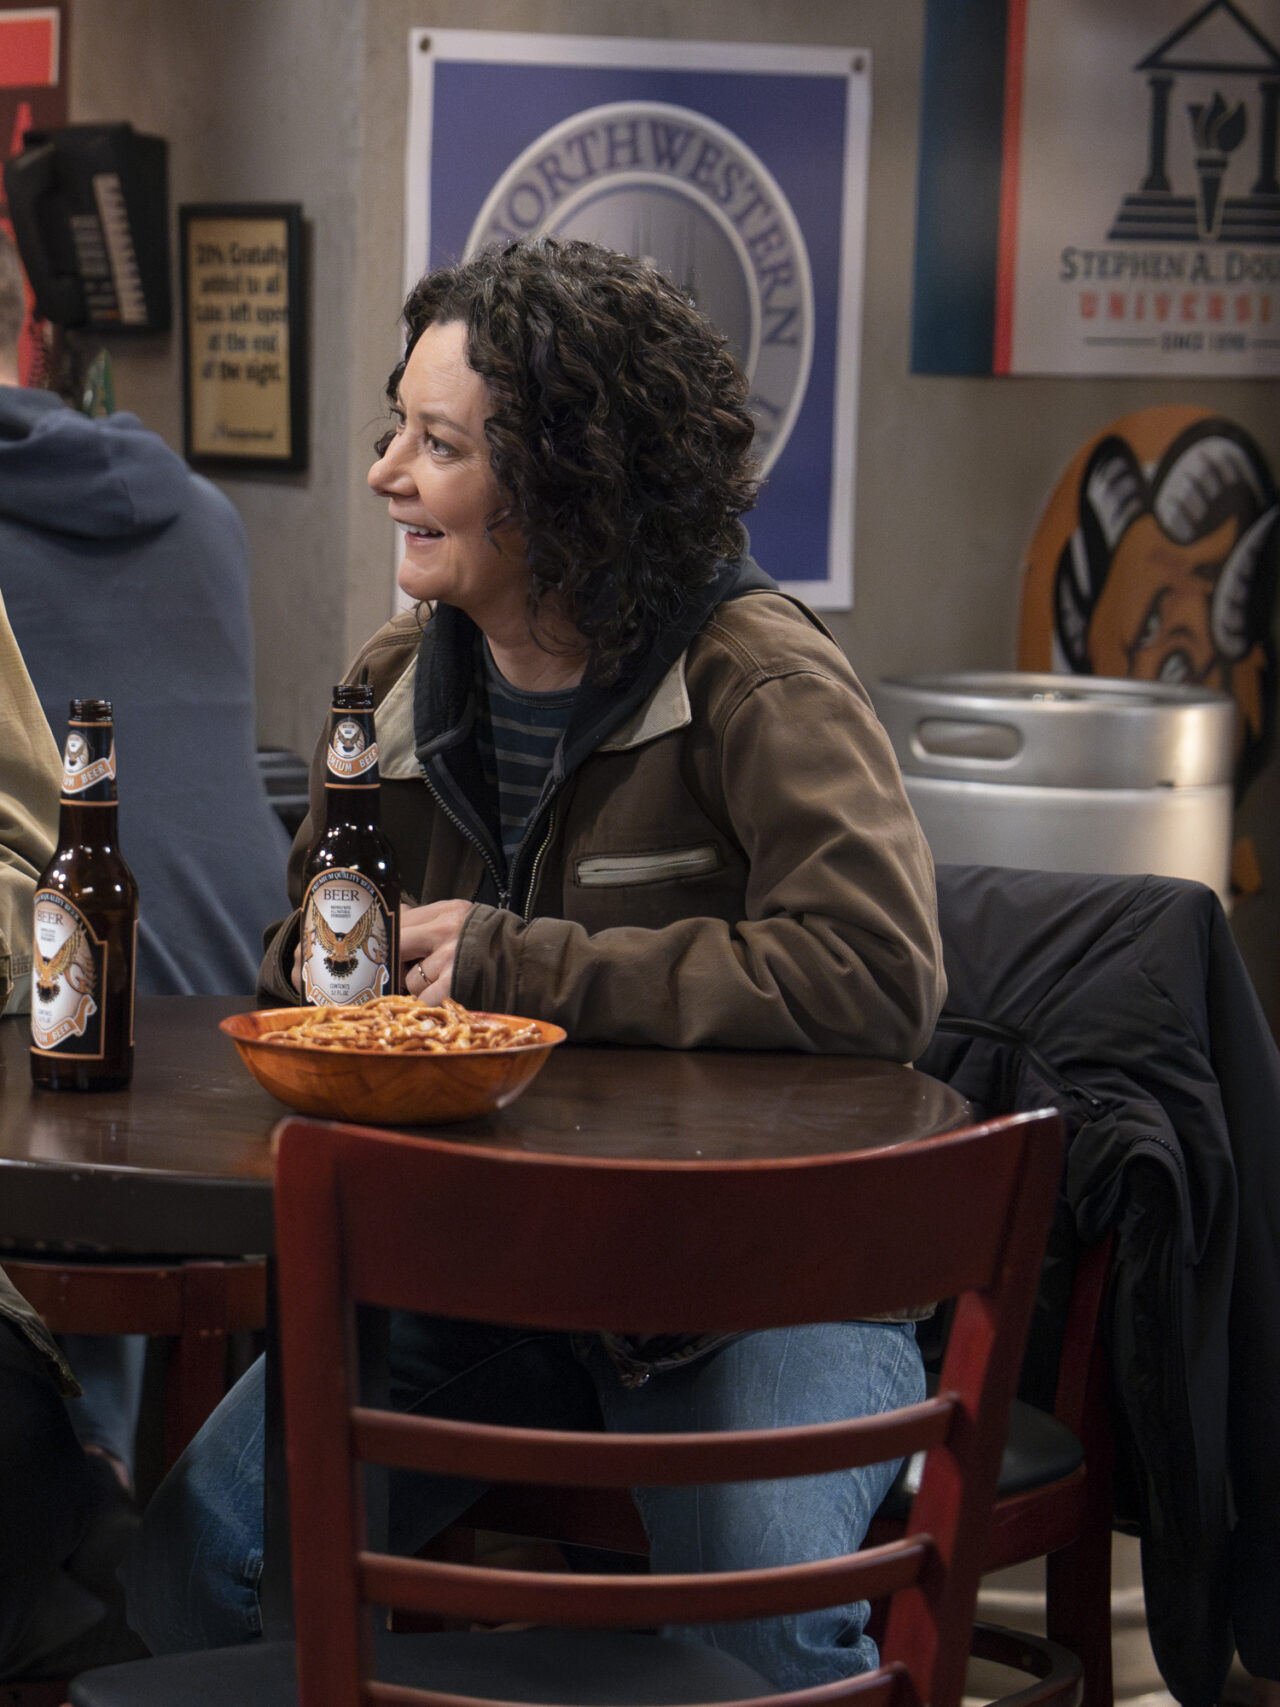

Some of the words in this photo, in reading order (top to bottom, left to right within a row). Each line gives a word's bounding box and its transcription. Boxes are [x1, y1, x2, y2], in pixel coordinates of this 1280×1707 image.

[360, 748, 377, 769] BEER
[81, 763, 105, 786] BEER
[323, 888, 360, 902] BEER
[37, 909, 64, 927] BEER
[52, 1022, 71, 1040] BEER
